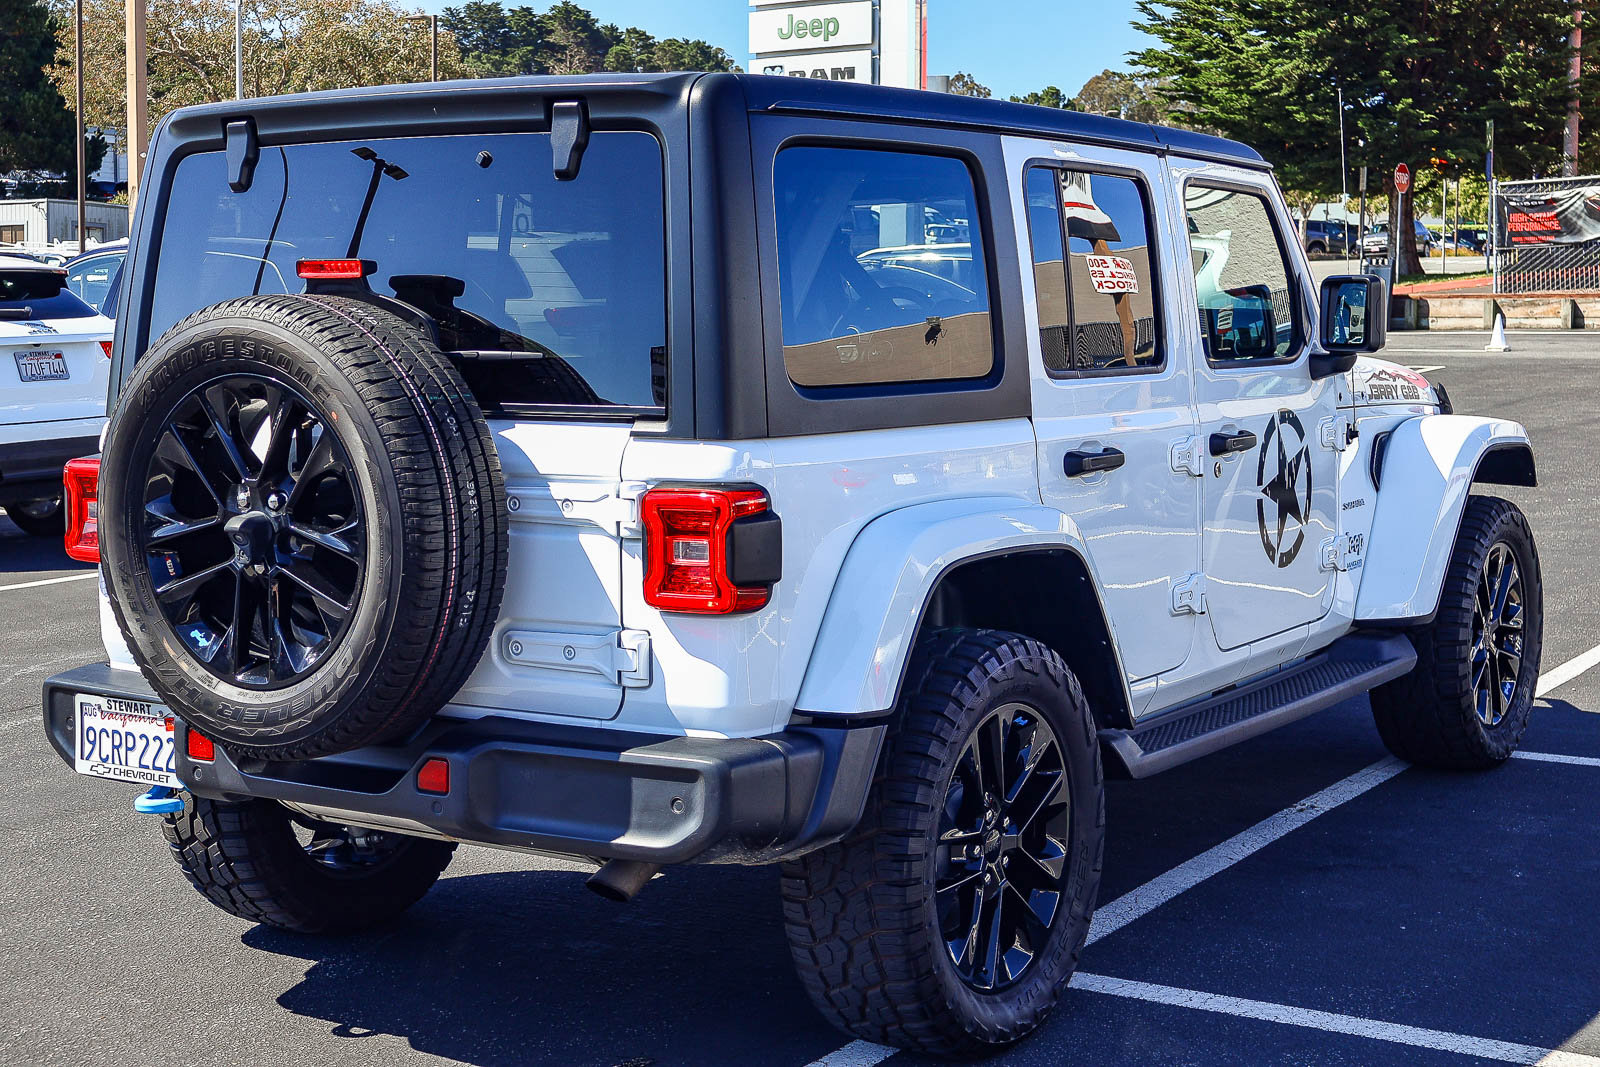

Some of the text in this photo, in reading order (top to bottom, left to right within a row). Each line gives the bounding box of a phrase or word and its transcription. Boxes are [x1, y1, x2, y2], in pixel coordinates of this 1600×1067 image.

[777, 14, 840, 42] Jeep
[1395, 172, 1409, 184] STOP
[139, 339, 332, 408] BRIDGESTONE
[214, 645, 354, 724] DUELER
[84, 706, 98, 718] AUG
[107, 699, 151, 715] STEWART
[86, 726, 177, 773] 9CRP222
[113, 767, 171, 784] CHEVROLET
